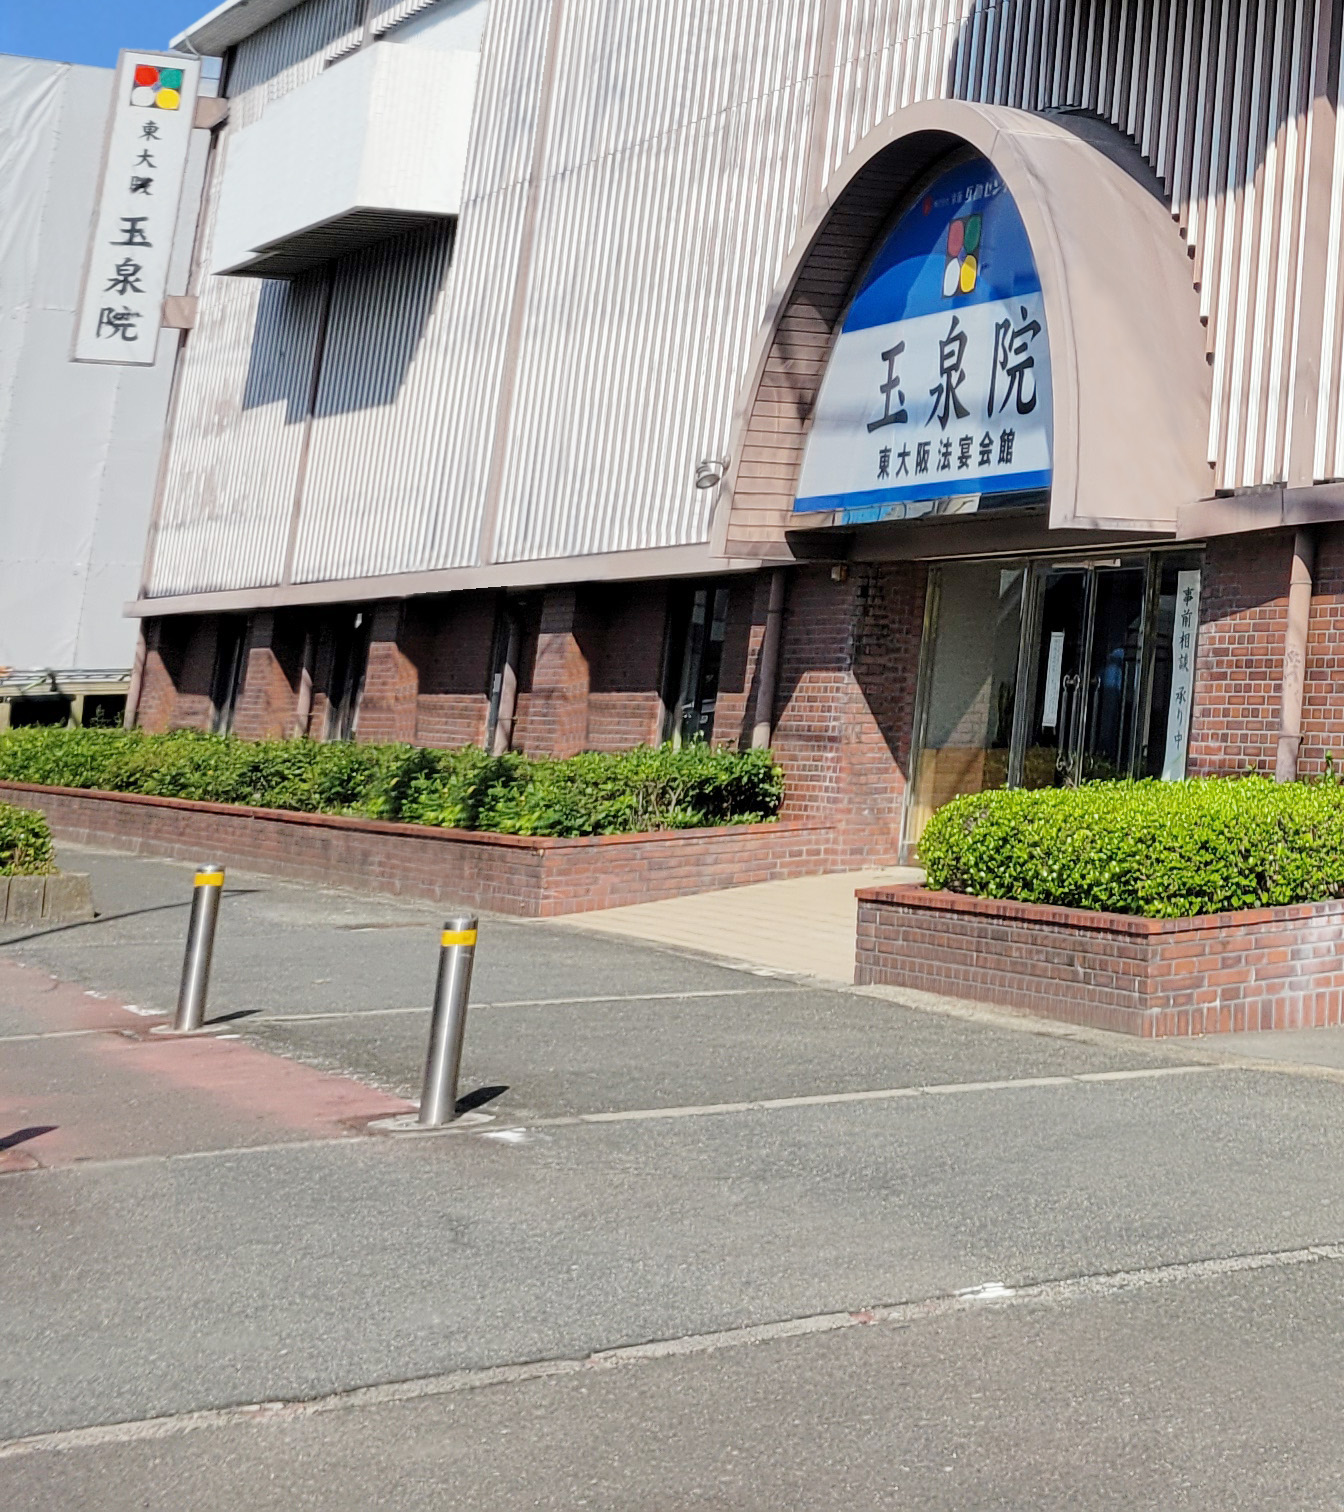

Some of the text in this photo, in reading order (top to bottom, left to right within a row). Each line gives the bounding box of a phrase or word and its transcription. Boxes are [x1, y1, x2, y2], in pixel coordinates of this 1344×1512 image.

[96, 216, 152, 341] 玉泉院
[867, 305, 1041, 433] 玉泉院
[877, 428, 1015, 480] 東大阪法宴会館
